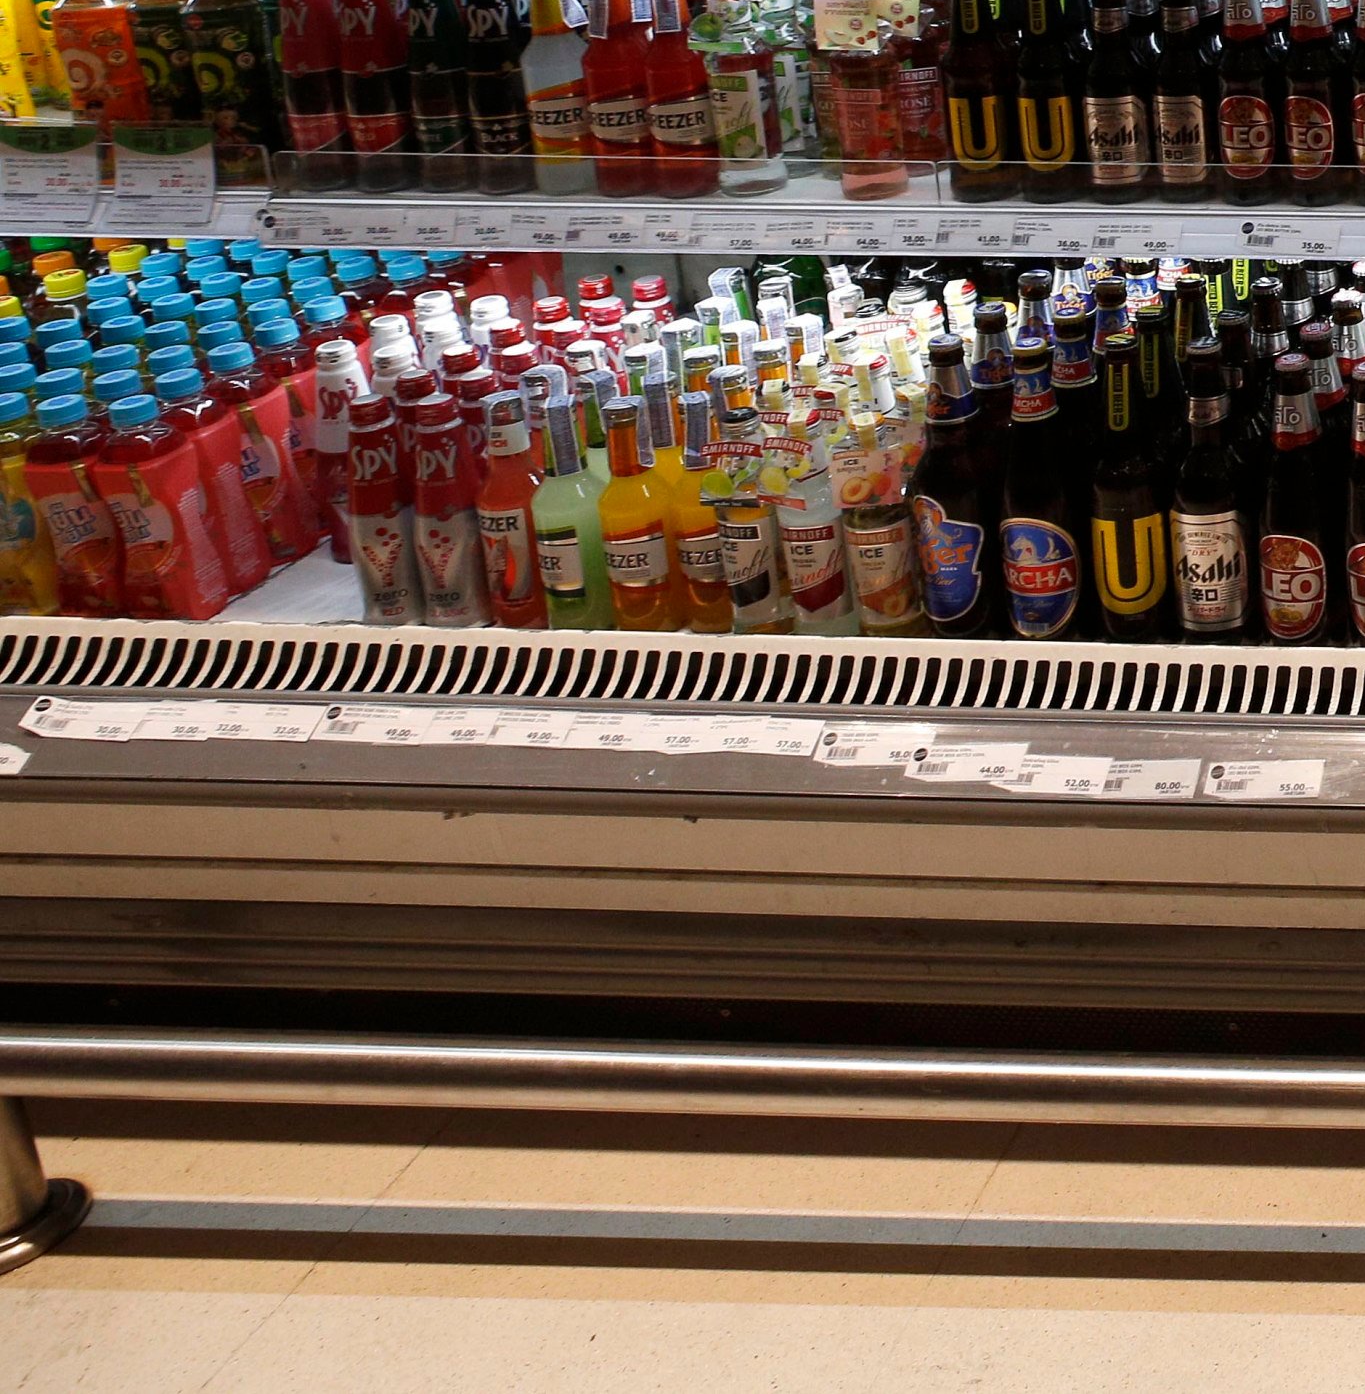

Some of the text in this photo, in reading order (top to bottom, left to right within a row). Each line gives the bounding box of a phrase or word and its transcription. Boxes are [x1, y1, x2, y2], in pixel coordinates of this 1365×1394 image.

[949, 95, 999, 171] U
[729, 239, 753, 247] 57.00
[1143, 241, 1167, 249] 49.00
[790, 544, 815, 557] ICE
[1175, 551, 1241, 586] Asahi
[979, 765, 1006, 775] 44.00
[1064, 778, 1091, 789] 52.00
[1154, 781, 1181, 791] 80.00
[1278, 782, 1306, 793] 55.00
